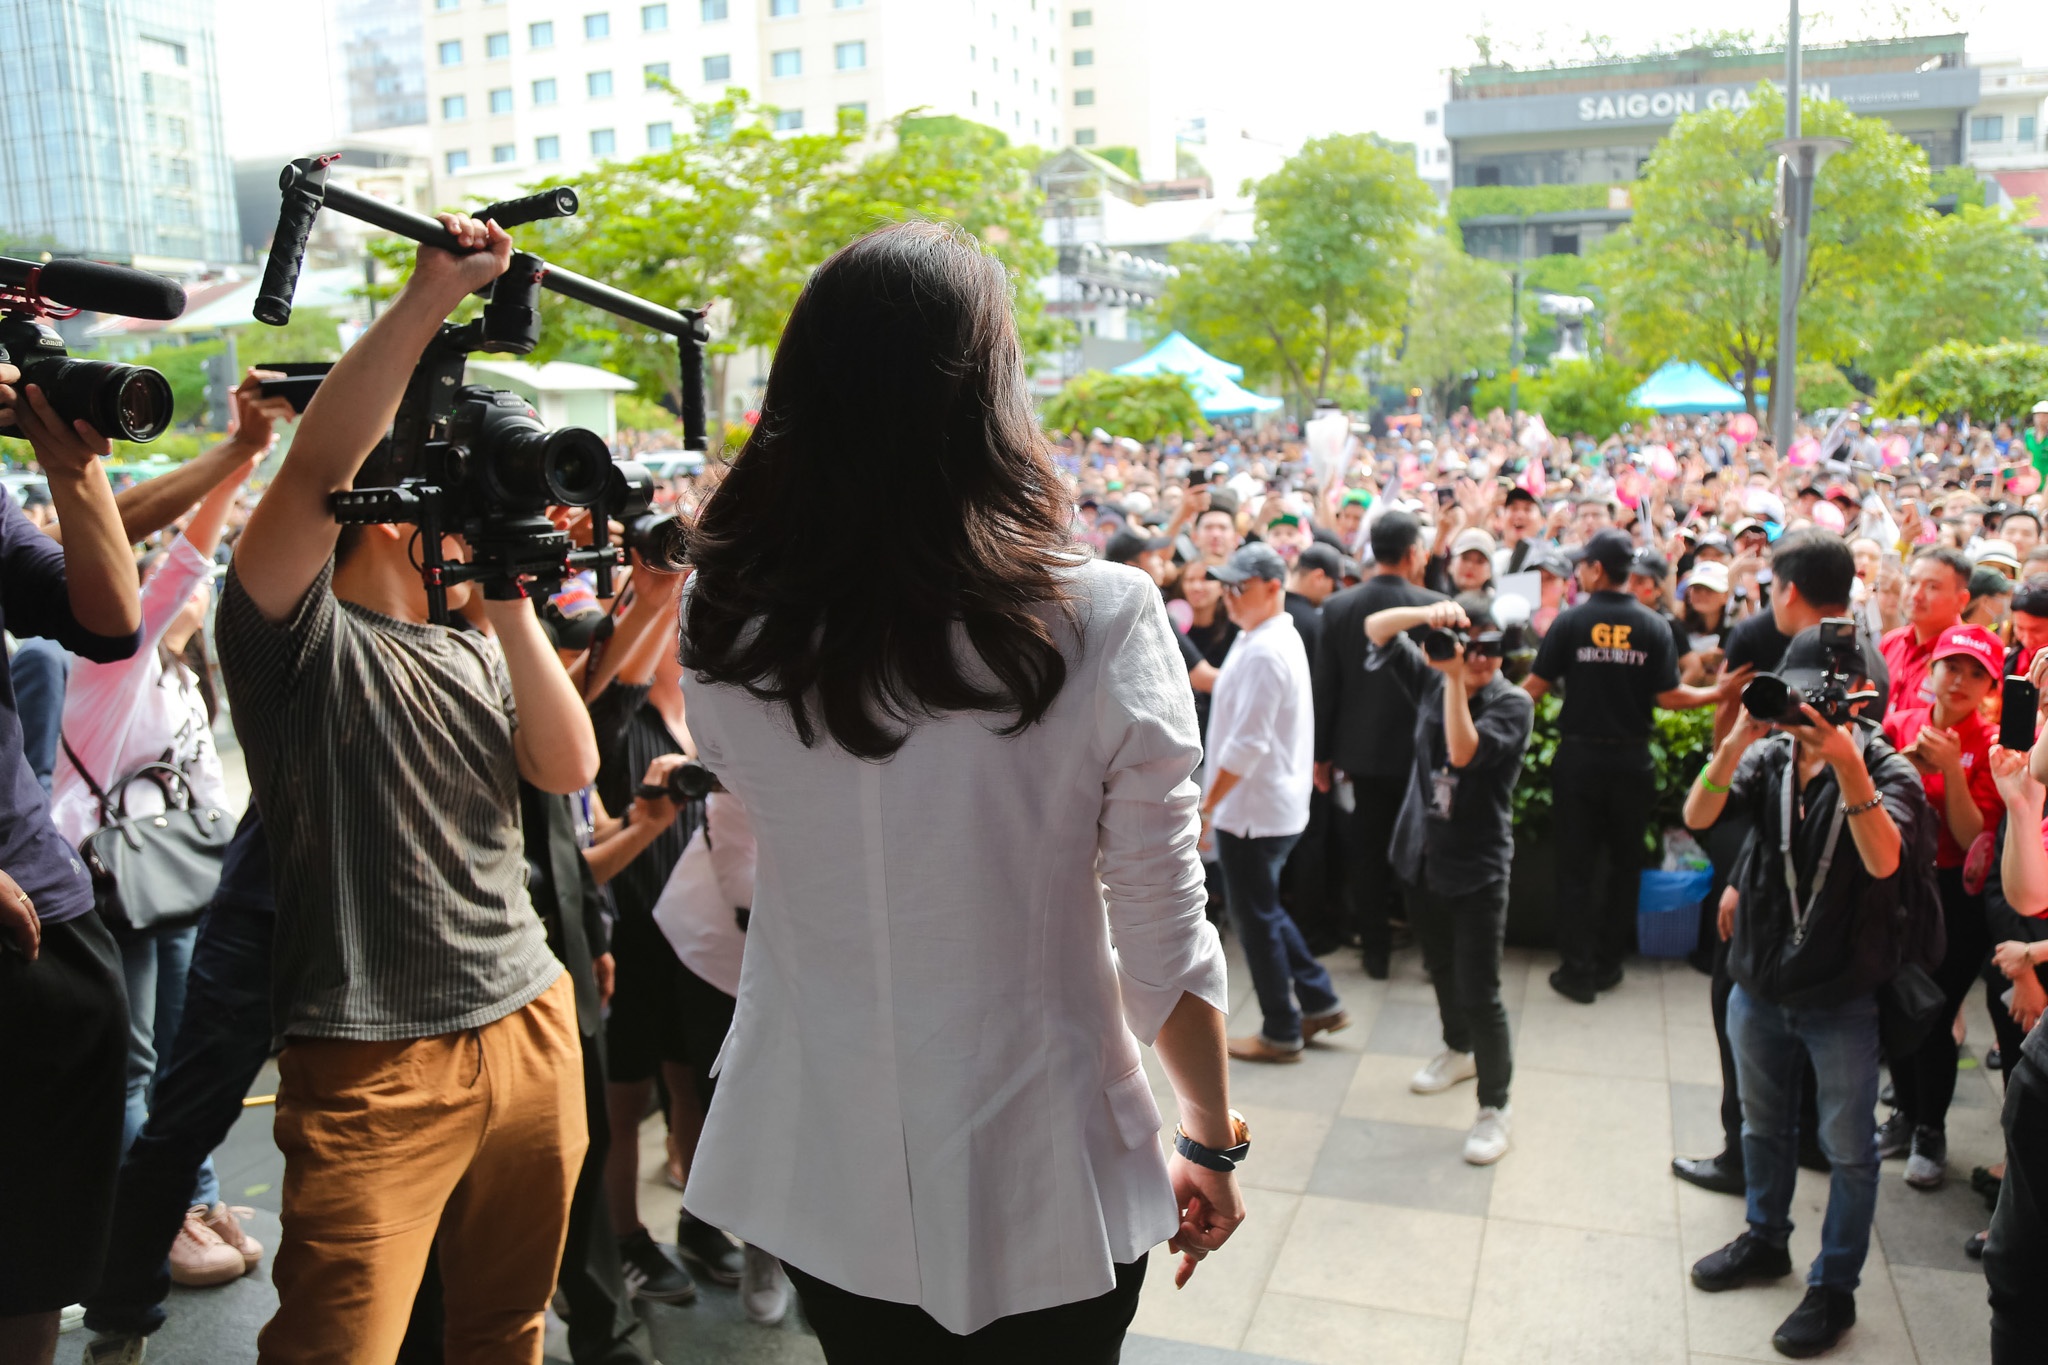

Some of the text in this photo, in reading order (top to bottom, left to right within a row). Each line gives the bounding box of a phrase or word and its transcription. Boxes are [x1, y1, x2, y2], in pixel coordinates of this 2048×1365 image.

[1578, 91, 1696, 121] SAIGON
[39, 338, 63, 347] Canon
[1591, 622, 1632, 650] GE
[1577, 646, 1648, 666] SECURITY
